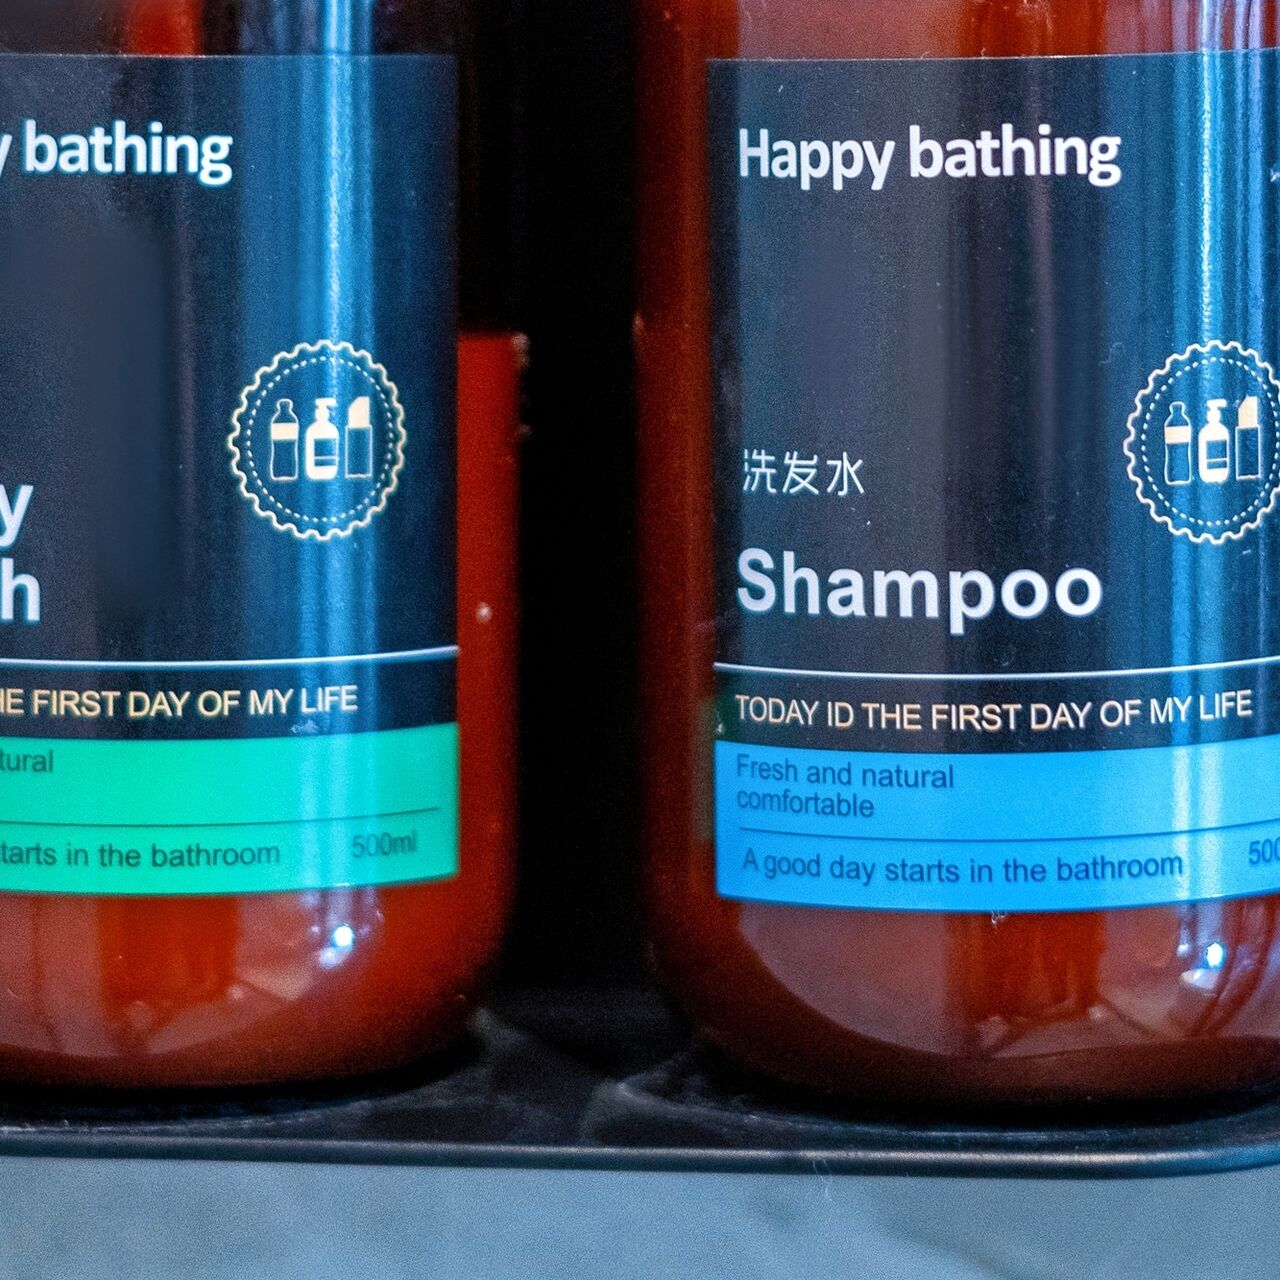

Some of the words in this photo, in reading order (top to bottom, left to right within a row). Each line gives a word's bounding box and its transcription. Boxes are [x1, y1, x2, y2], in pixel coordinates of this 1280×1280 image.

[24, 120, 233, 186] bathing
[739, 127, 895, 190] Happy
[909, 124, 1121, 187] bathing
[741, 448, 864, 495] 洗发水
[737, 548, 1102, 634] Shampoo
[32, 689, 121, 718] FIRST
[128, 691, 187, 718] DAY
[197, 689, 240, 717] OF
[249, 688, 293, 715] MY
[301, 685, 358, 713] LIFE
[736, 695, 819, 726] TODAY
[827, 701, 855, 728] ID
[860, 703, 922, 730] THE
[931, 704, 1022, 730] FIRST
[1030, 701, 1091, 730] DAY
[1100, 699, 1141, 727] OF
[1150, 695, 1192, 723] MY
[1199, 690, 1252, 720] LIFE
[736, 754, 799, 783] Fresh
[807, 761, 852, 786] and
[862, 763, 954, 789] natural
[736, 789, 875, 818] comfortable
[65, 843, 90, 868] in
[99, 842, 141, 869] the
[151, 839, 280, 868] bathroom
[351, 831, 417, 859] 500ml
[743, 848, 760, 870] A
[764, 853, 821, 879] good
[829, 855, 875, 885] day
[885, 857, 960, 884] starts
[969, 858, 993, 884] in
[1004, 857, 1046, 883] the
[1056, 852, 1182, 883] bathroom
